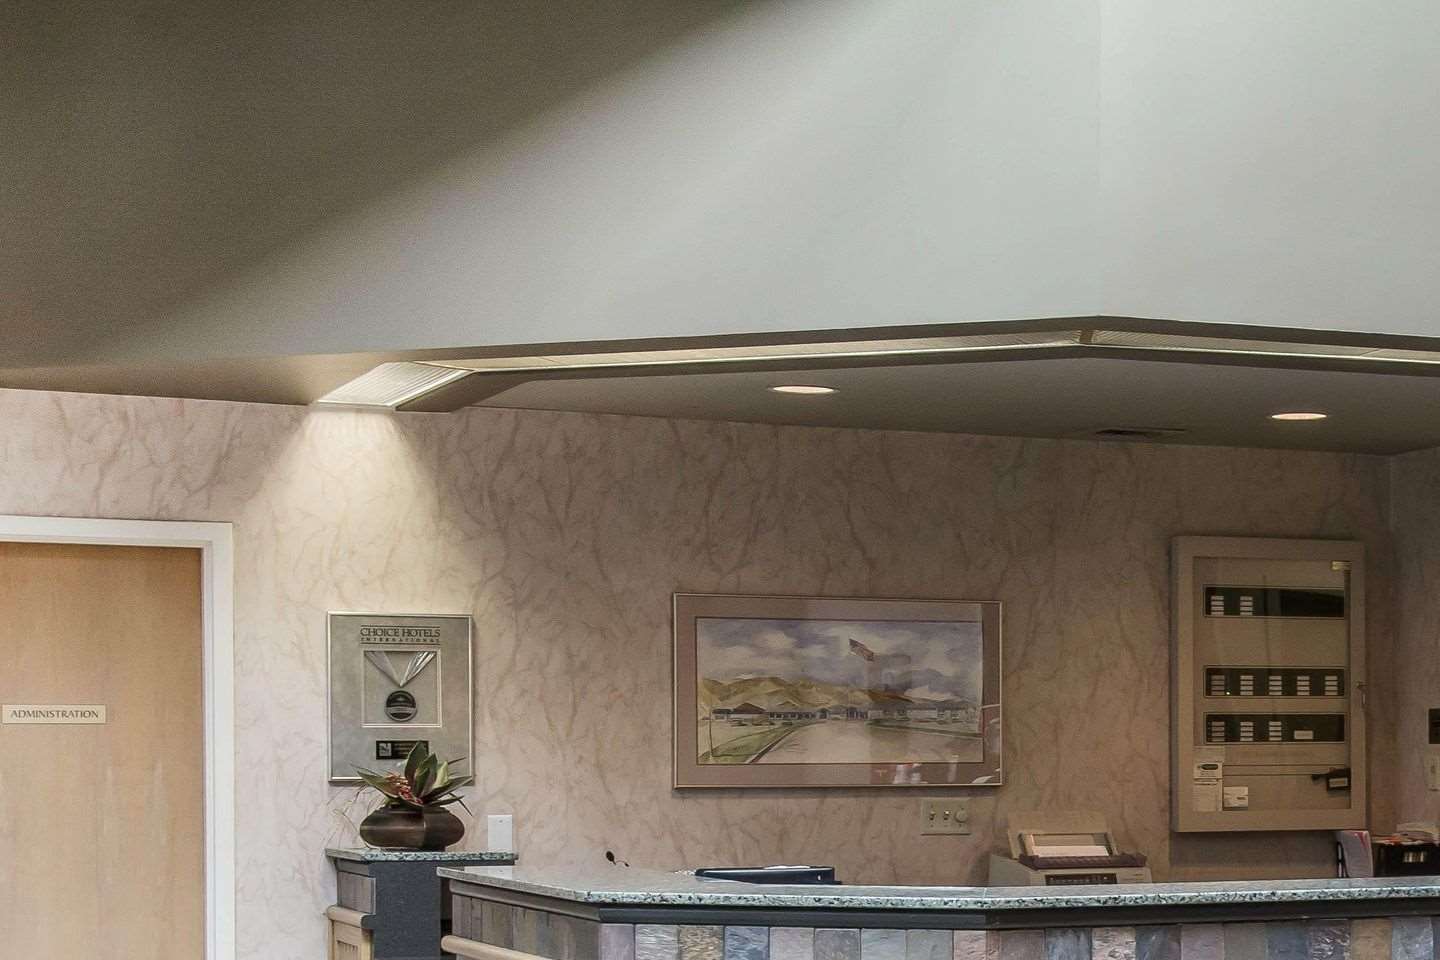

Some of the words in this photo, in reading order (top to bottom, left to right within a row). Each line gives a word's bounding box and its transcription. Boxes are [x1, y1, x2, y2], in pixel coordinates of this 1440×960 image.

[360, 628, 400, 637] CHOICE
[402, 628, 440, 638] HOTELS
[10, 709, 99, 719] ADMINISTRATION
